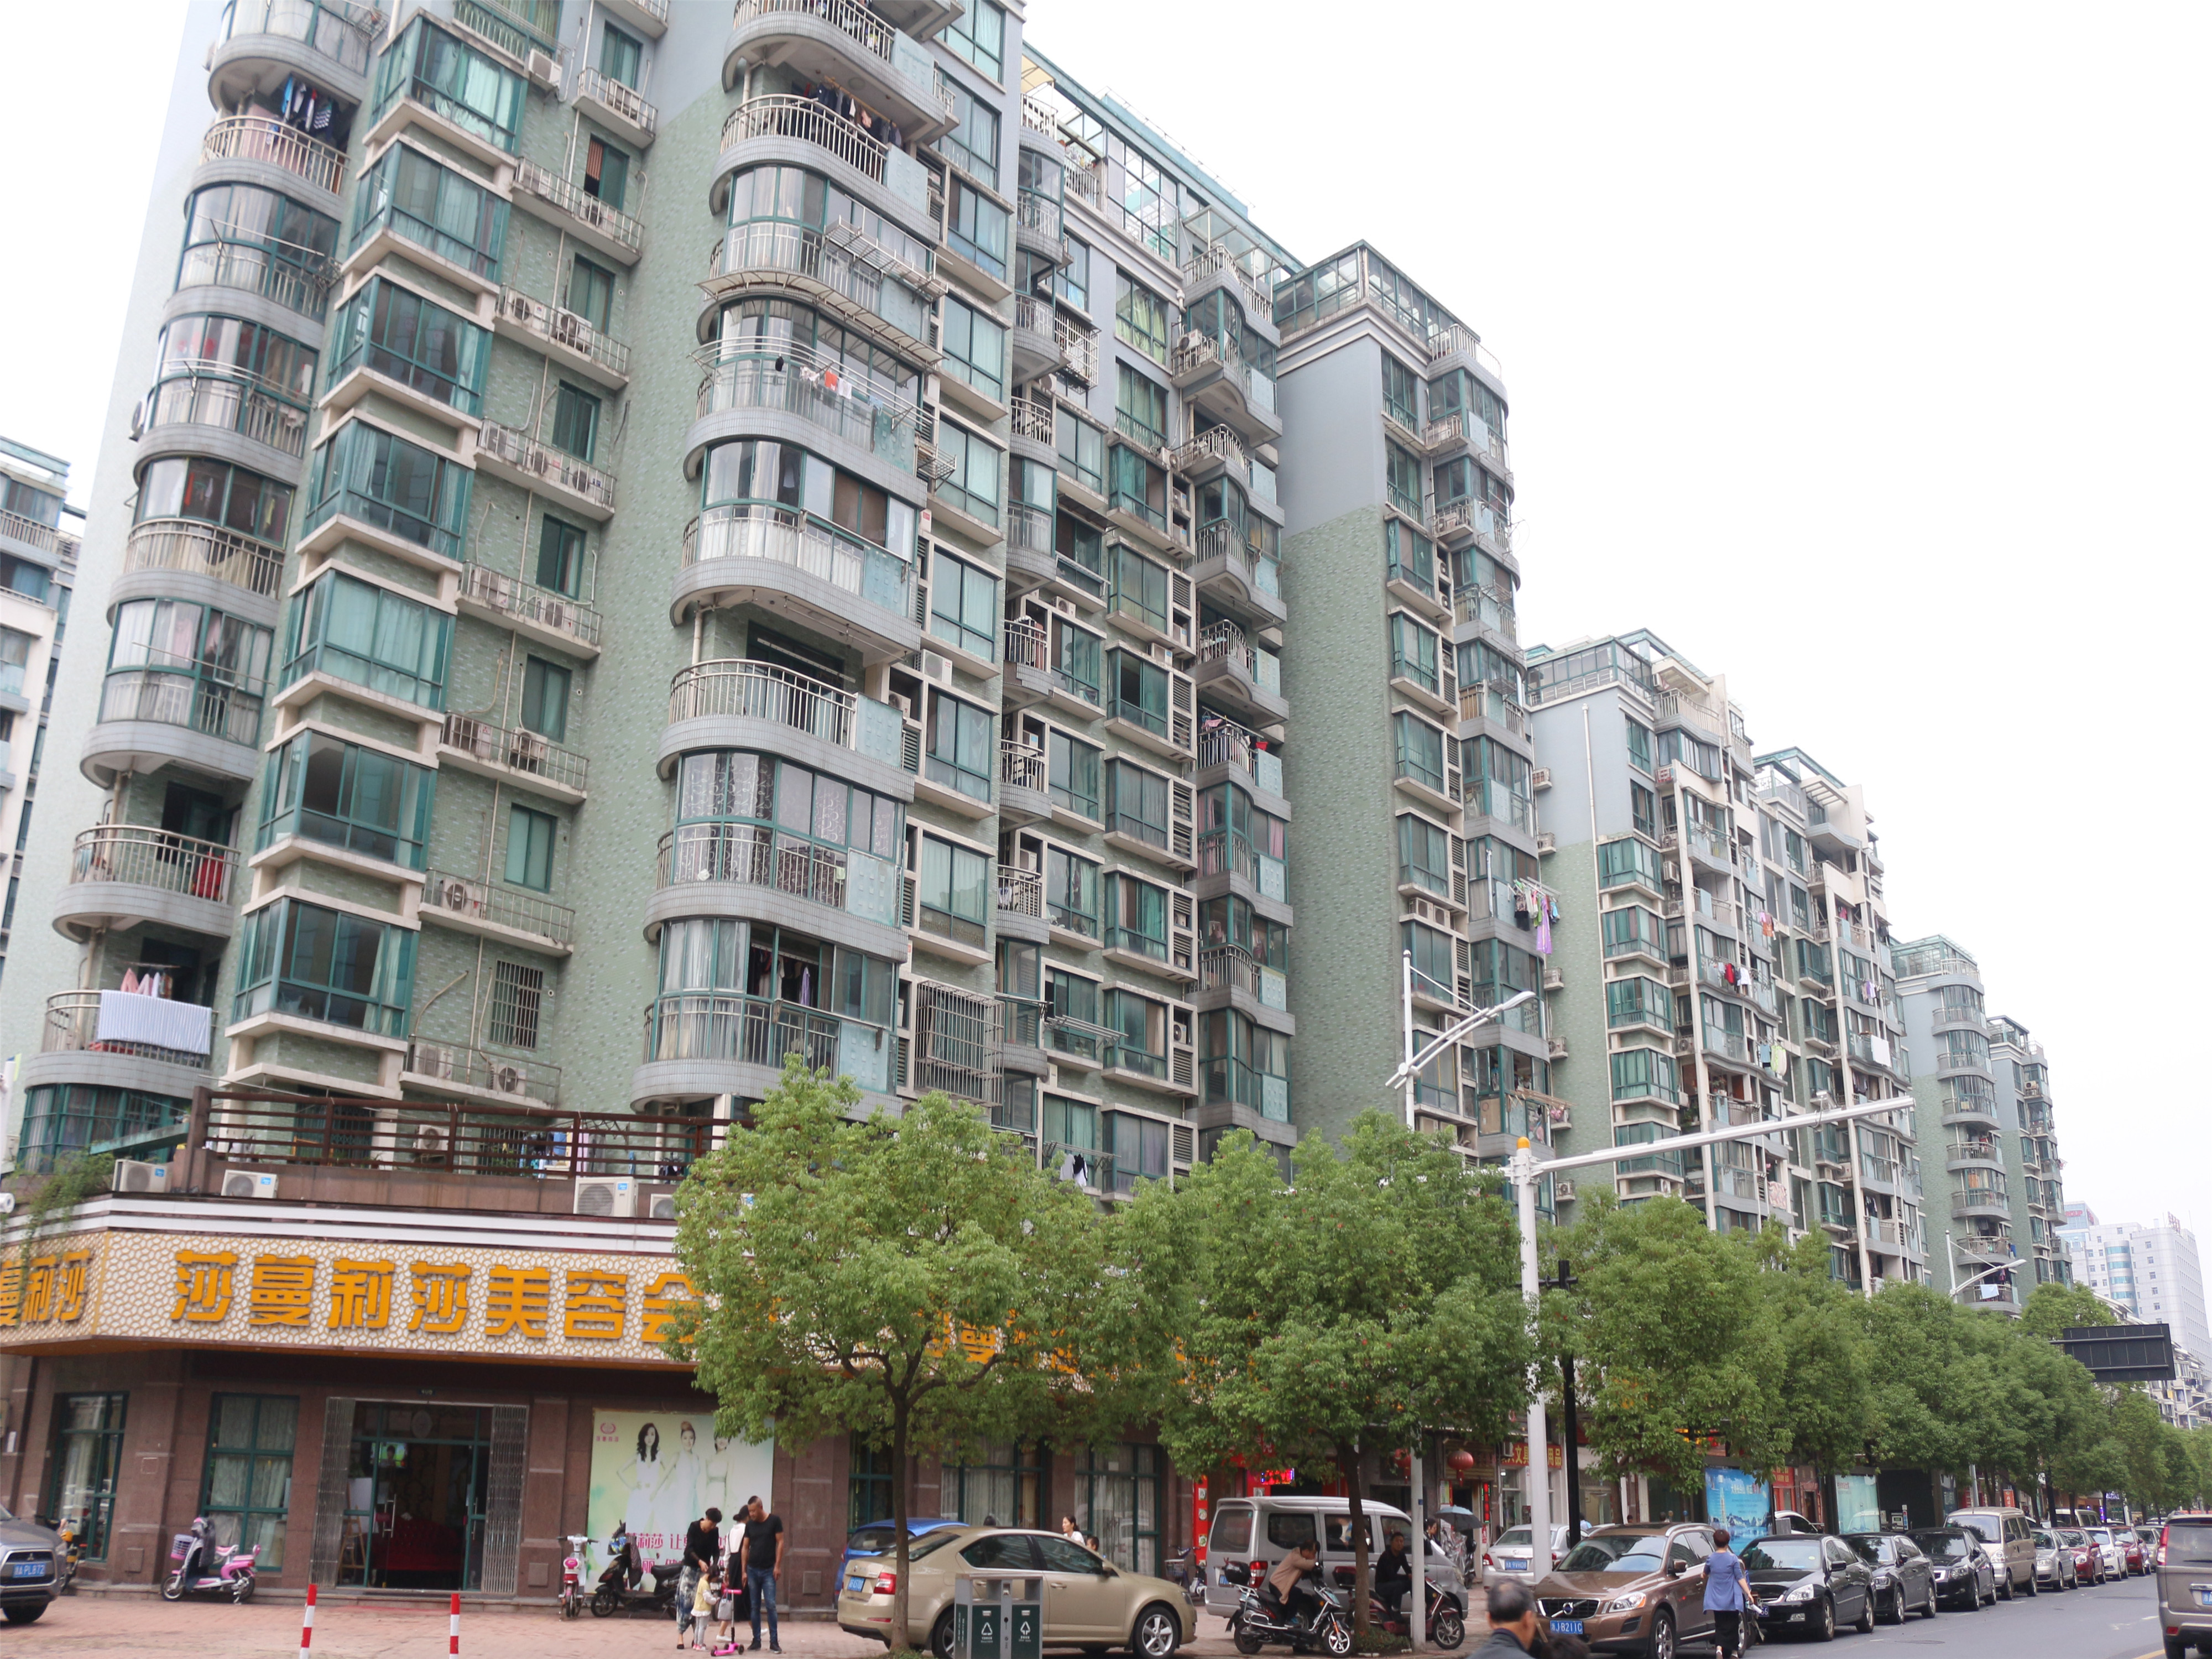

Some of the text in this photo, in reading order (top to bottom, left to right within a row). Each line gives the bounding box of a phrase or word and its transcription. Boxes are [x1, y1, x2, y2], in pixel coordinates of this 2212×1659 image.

[170, 1249, 705, 1343] 莎曼莉莎美容会
[625, 1532, 664, 1549] 莉莎
